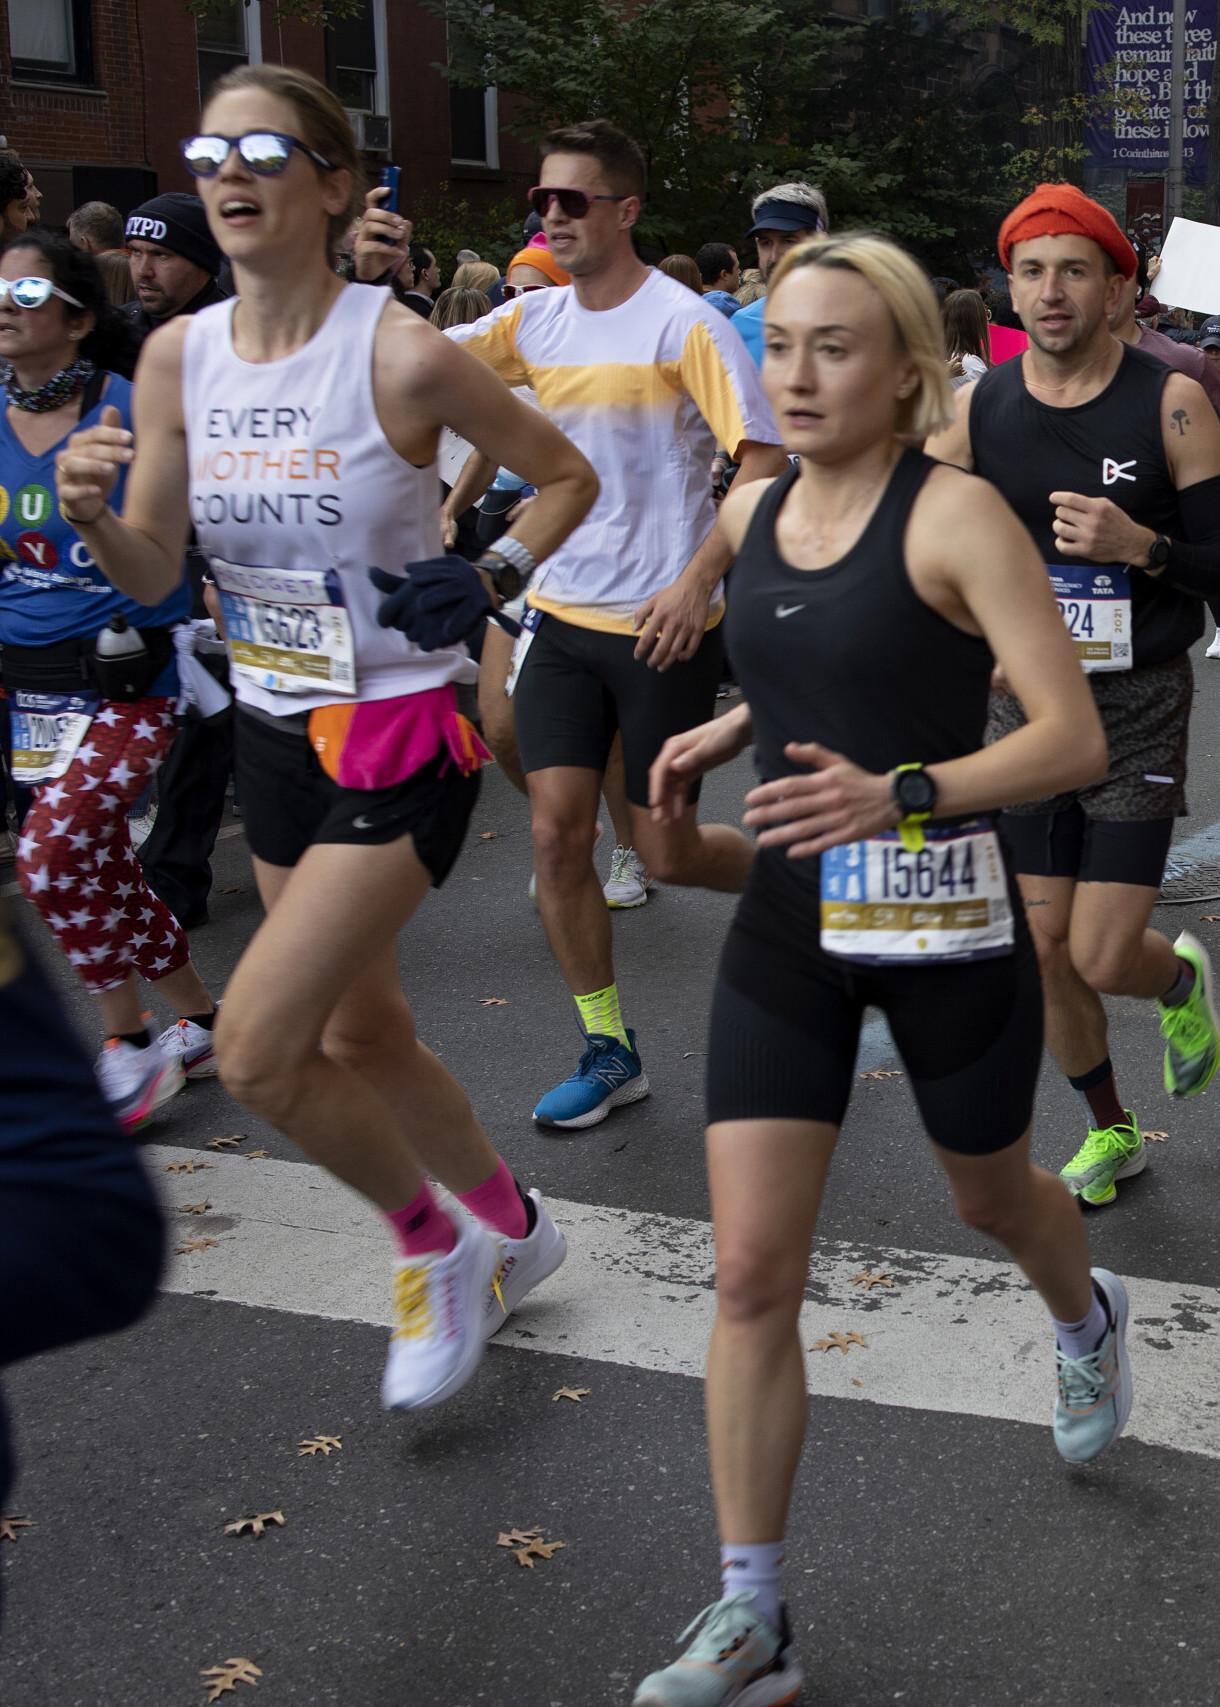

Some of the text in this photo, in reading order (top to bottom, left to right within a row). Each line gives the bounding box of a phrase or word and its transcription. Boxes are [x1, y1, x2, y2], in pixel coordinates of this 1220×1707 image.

[1115, 6, 1198, 25] And nw
[1115, 25, 1212, 44] these tree
[1115, 61, 1199, 87] hope ad
[1158, 81, 1192, 100] Bt
[1193, 79, 1211, 100] th
[1114, 119, 1162, 139] these
[1113, 149, 1119, 159] 1
[1119, 147, 1171, 159] Corinthians
[206, 407, 322, 439] EVERY
[191, 494, 344, 526] COUNTS
[1114, 608, 1123, 634] 2021
[882, 841, 977, 898] 15644
[845, 873, 862, 900] A
